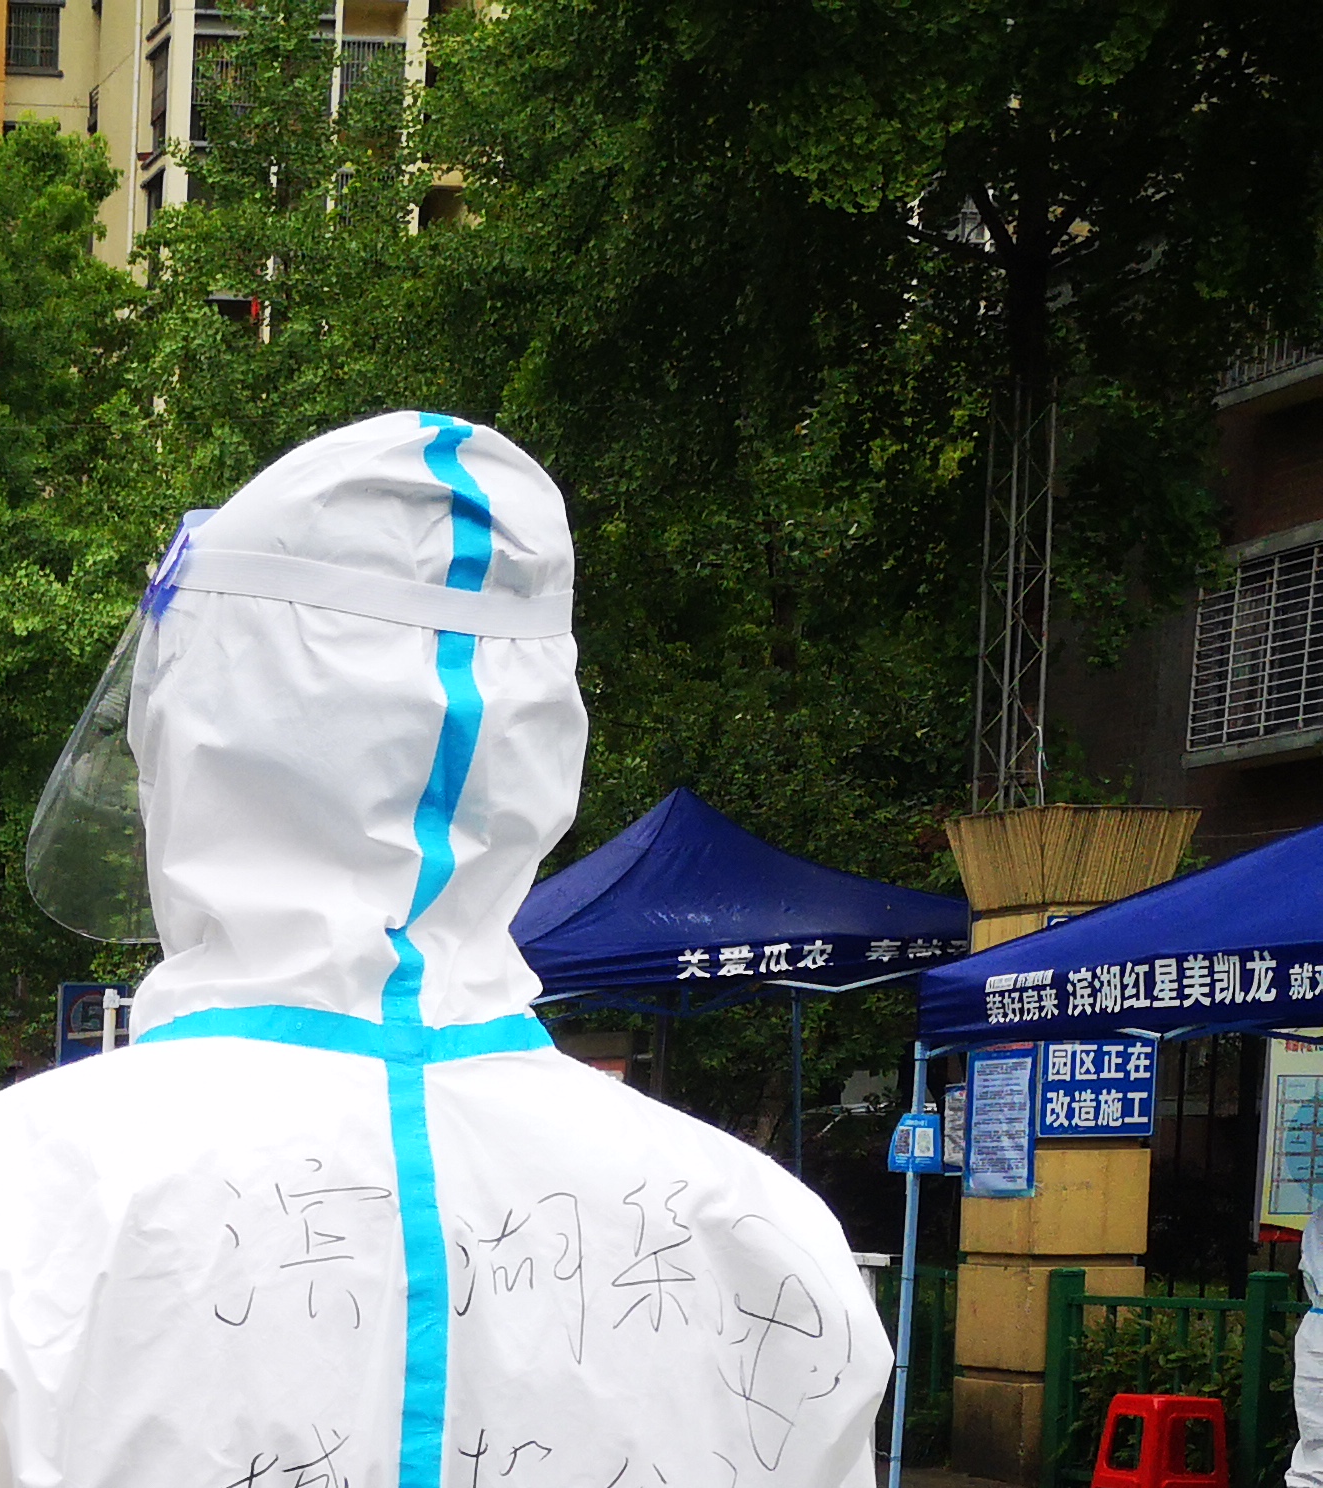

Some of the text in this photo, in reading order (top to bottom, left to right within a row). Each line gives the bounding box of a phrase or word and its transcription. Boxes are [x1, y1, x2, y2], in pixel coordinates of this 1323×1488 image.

[677, 939, 834, 979] 关爱瓜农
[986, 986, 1059, 1025] 装好房来
[1066, 950, 1277, 1017] 滨湖红星美凯龙
[1046, 1042, 1152, 1082] 园区正在
[1045, 1088, 1149, 1128] 改造施工
